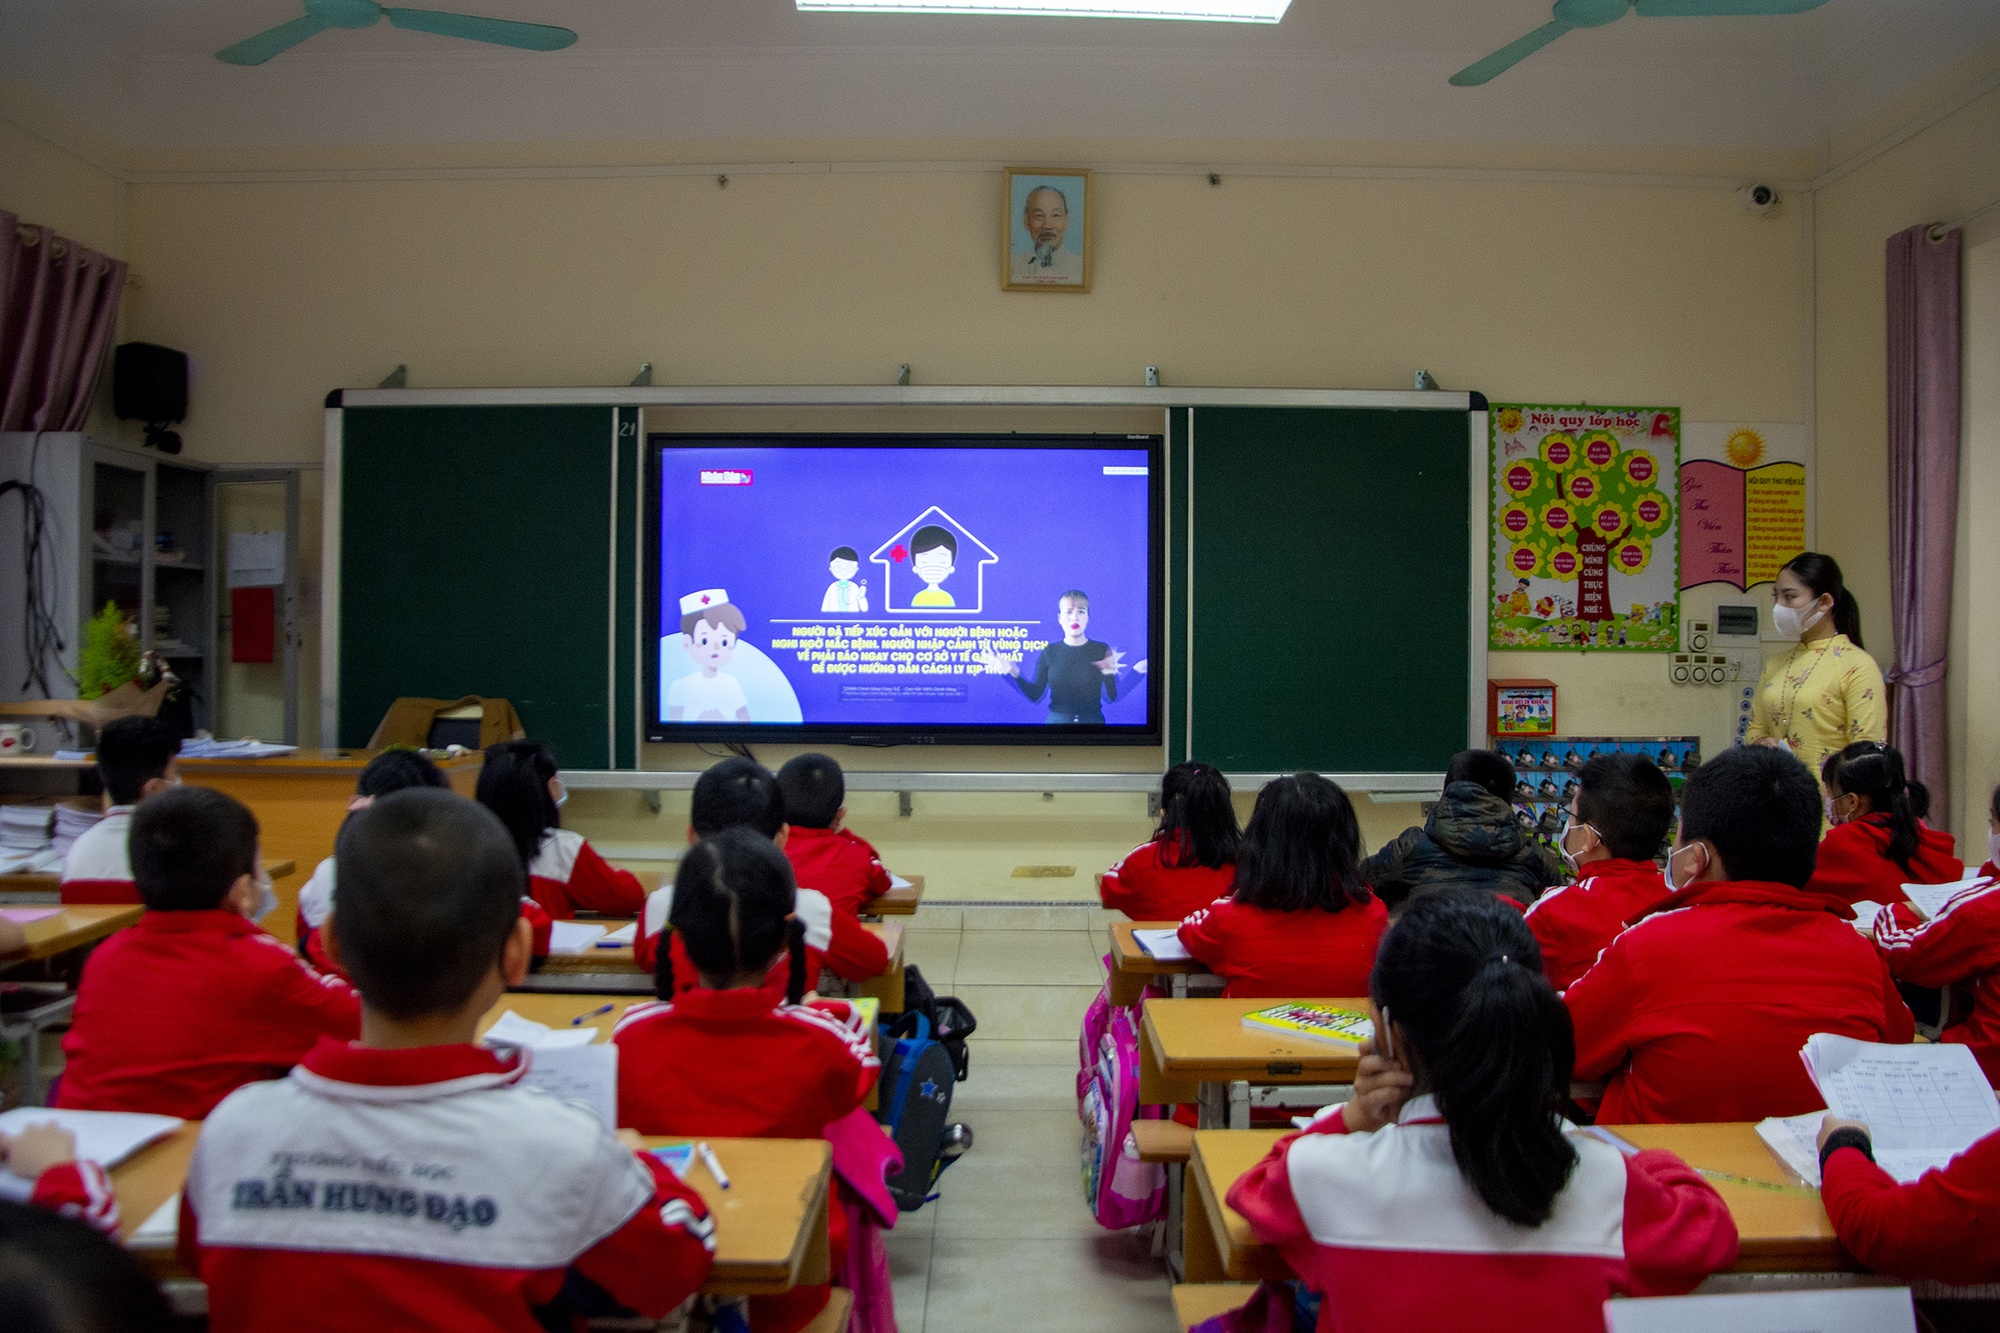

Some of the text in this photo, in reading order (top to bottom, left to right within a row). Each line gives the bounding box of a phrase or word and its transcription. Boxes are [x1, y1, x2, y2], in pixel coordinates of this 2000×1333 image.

[1531, 413, 1641, 428] Nội quy lớp học
[619, 422, 636, 437] 21
[1582, 542, 1606, 552] CHÚNG
[792, 625, 826, 636] NGƯỜI
[827, 625, 843, 636] ĐÃ
[844, 624, 864, 636] TIẾP
[865, 625, 888, 636] XÚC
[914, 626, 933, 637] VỚI
[934, 626, 968, 638] NGƯỜI
[970, 626, 996, 639] BỆNH
[998, 626, 1028, 639] HOẶC
[772, 639, 798, 648] NGHI
[800, 637, 824, 648] NGỜ
[851, 637, 880, 650] BỆNH.
[882, 638, 915, 649] NGƯỜI
[917, 638, 945, 651] NHẬP
[1022, 640, 1049, 652] DỊCH
[837, 650, 859, 660] BÁO
[860, 652, 888, 660] NGAY
[950, 652, 958, 662] Y
[827, 663, 857, 675] ĐƯỢC
[858, 662, 896, 674] HƯỚNG
[922, 662, 952, 674] CÁCH
[954, 665, 965, 674] LY
